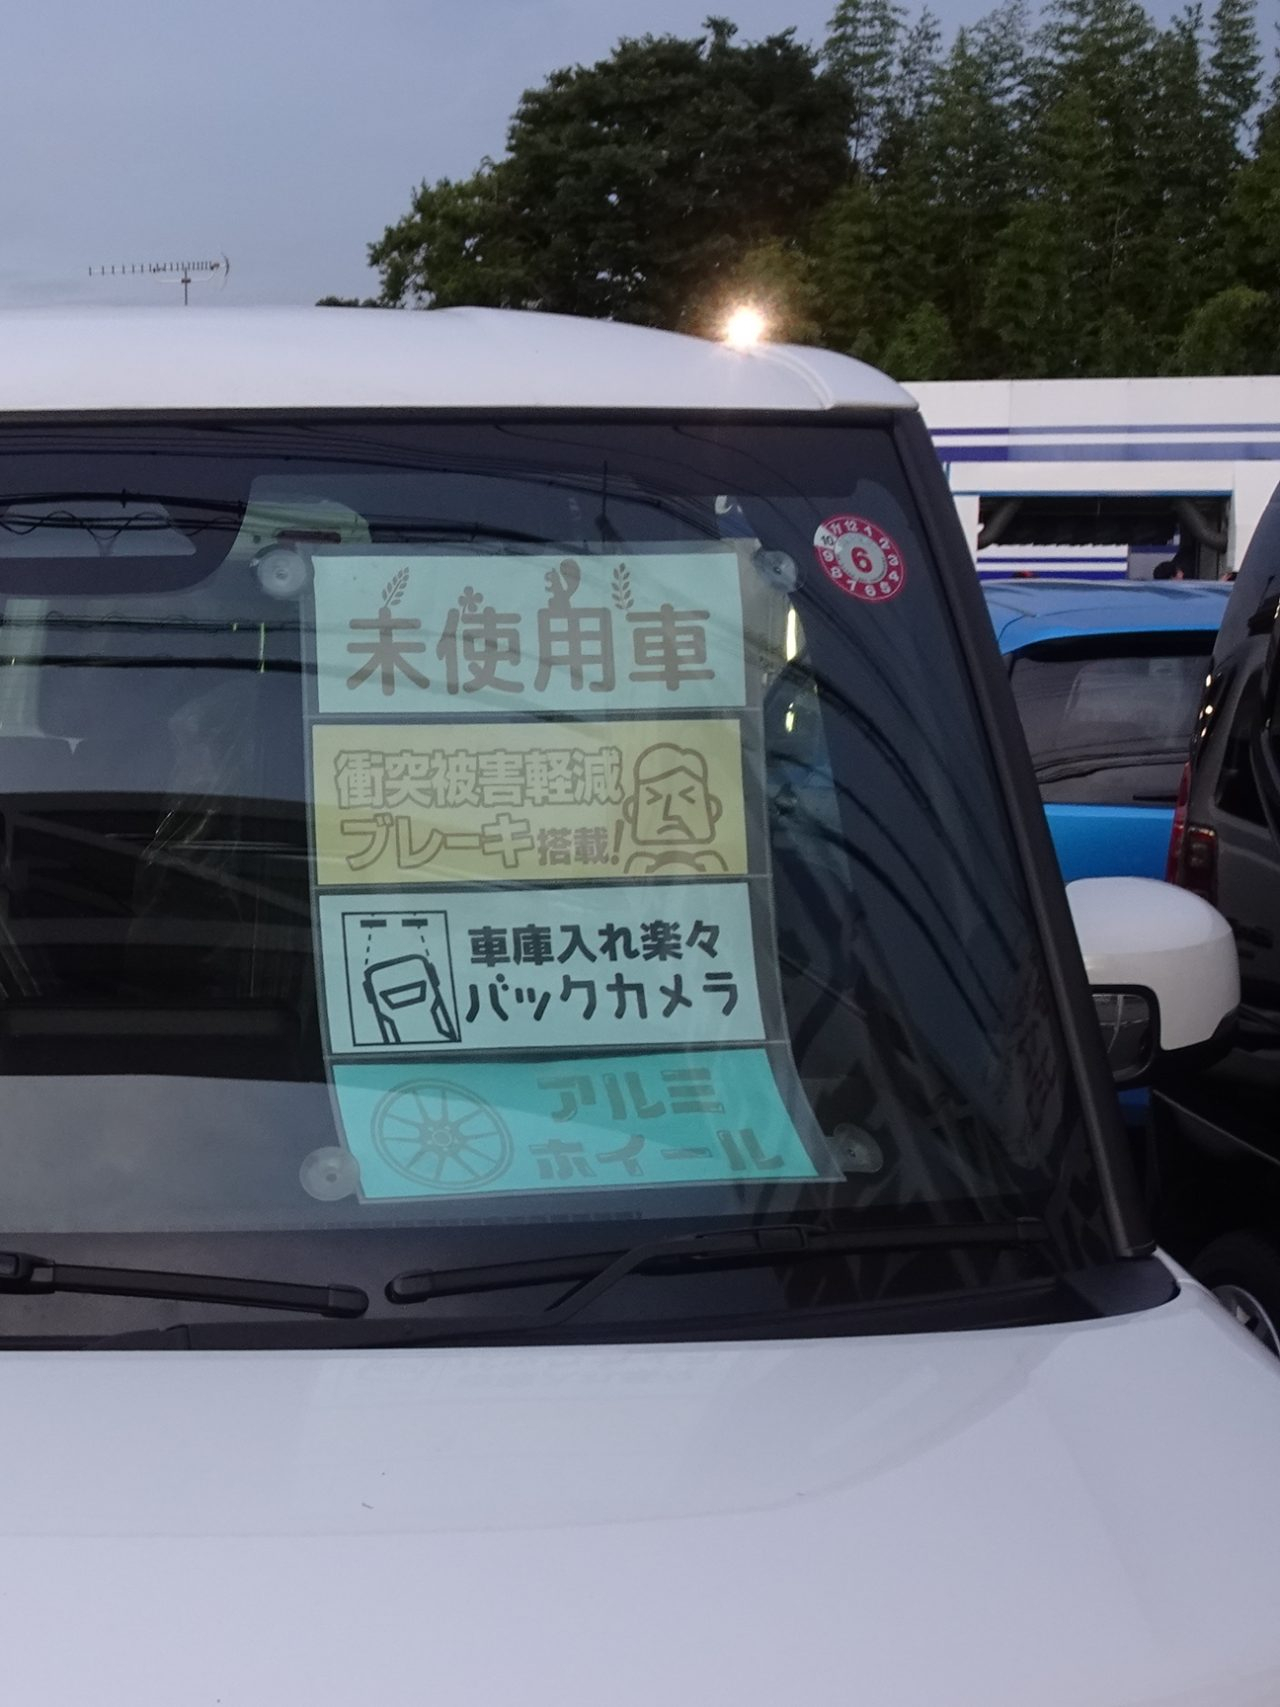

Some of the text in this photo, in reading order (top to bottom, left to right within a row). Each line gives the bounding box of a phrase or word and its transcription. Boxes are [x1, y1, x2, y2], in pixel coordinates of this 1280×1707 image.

[851, 547, 873, 573] 6
[346, 603, 716, 696] 未使用車
[334, 747, 625, 809] 衝突被害軽減
[467, 918, 720, 968] 車庫入れ楽々
[465, 972, 739, 1022] バックカメラ
[535, 1067, 726, 1123] アルミ
[527, 1127, 786, 1180] ホイール
